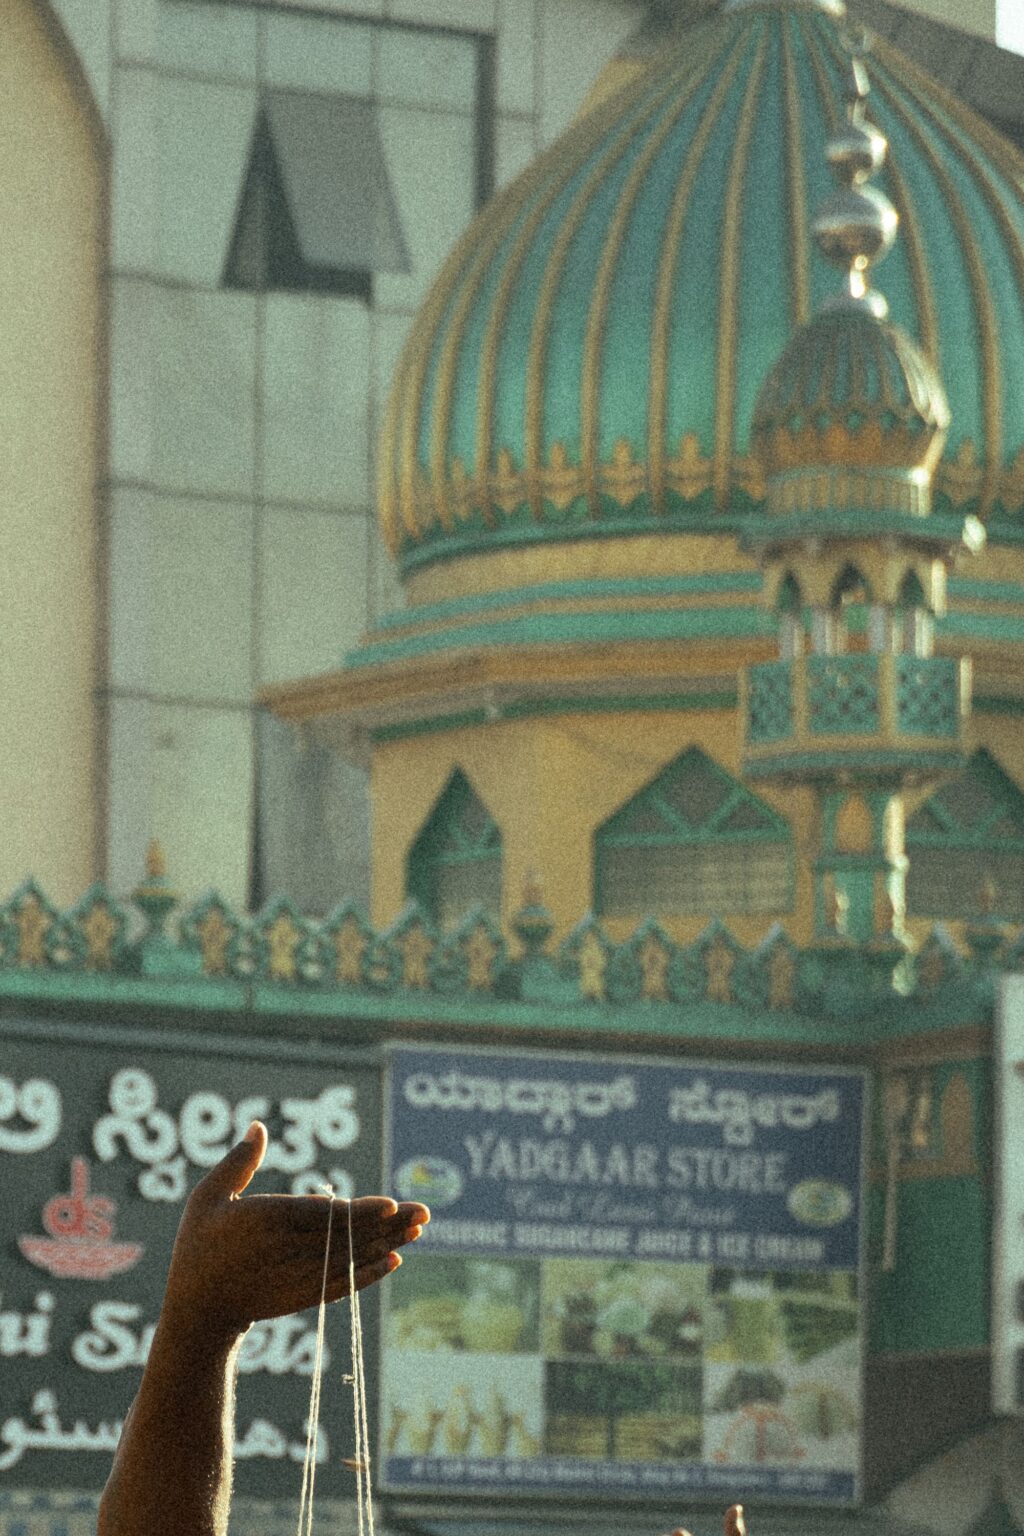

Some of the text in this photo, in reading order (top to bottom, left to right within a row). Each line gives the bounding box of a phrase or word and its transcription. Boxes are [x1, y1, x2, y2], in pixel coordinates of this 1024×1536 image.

[464, 1130, 788, 1192] YADGAAR STORE
[71, 1300, 330, 1375] Sets
